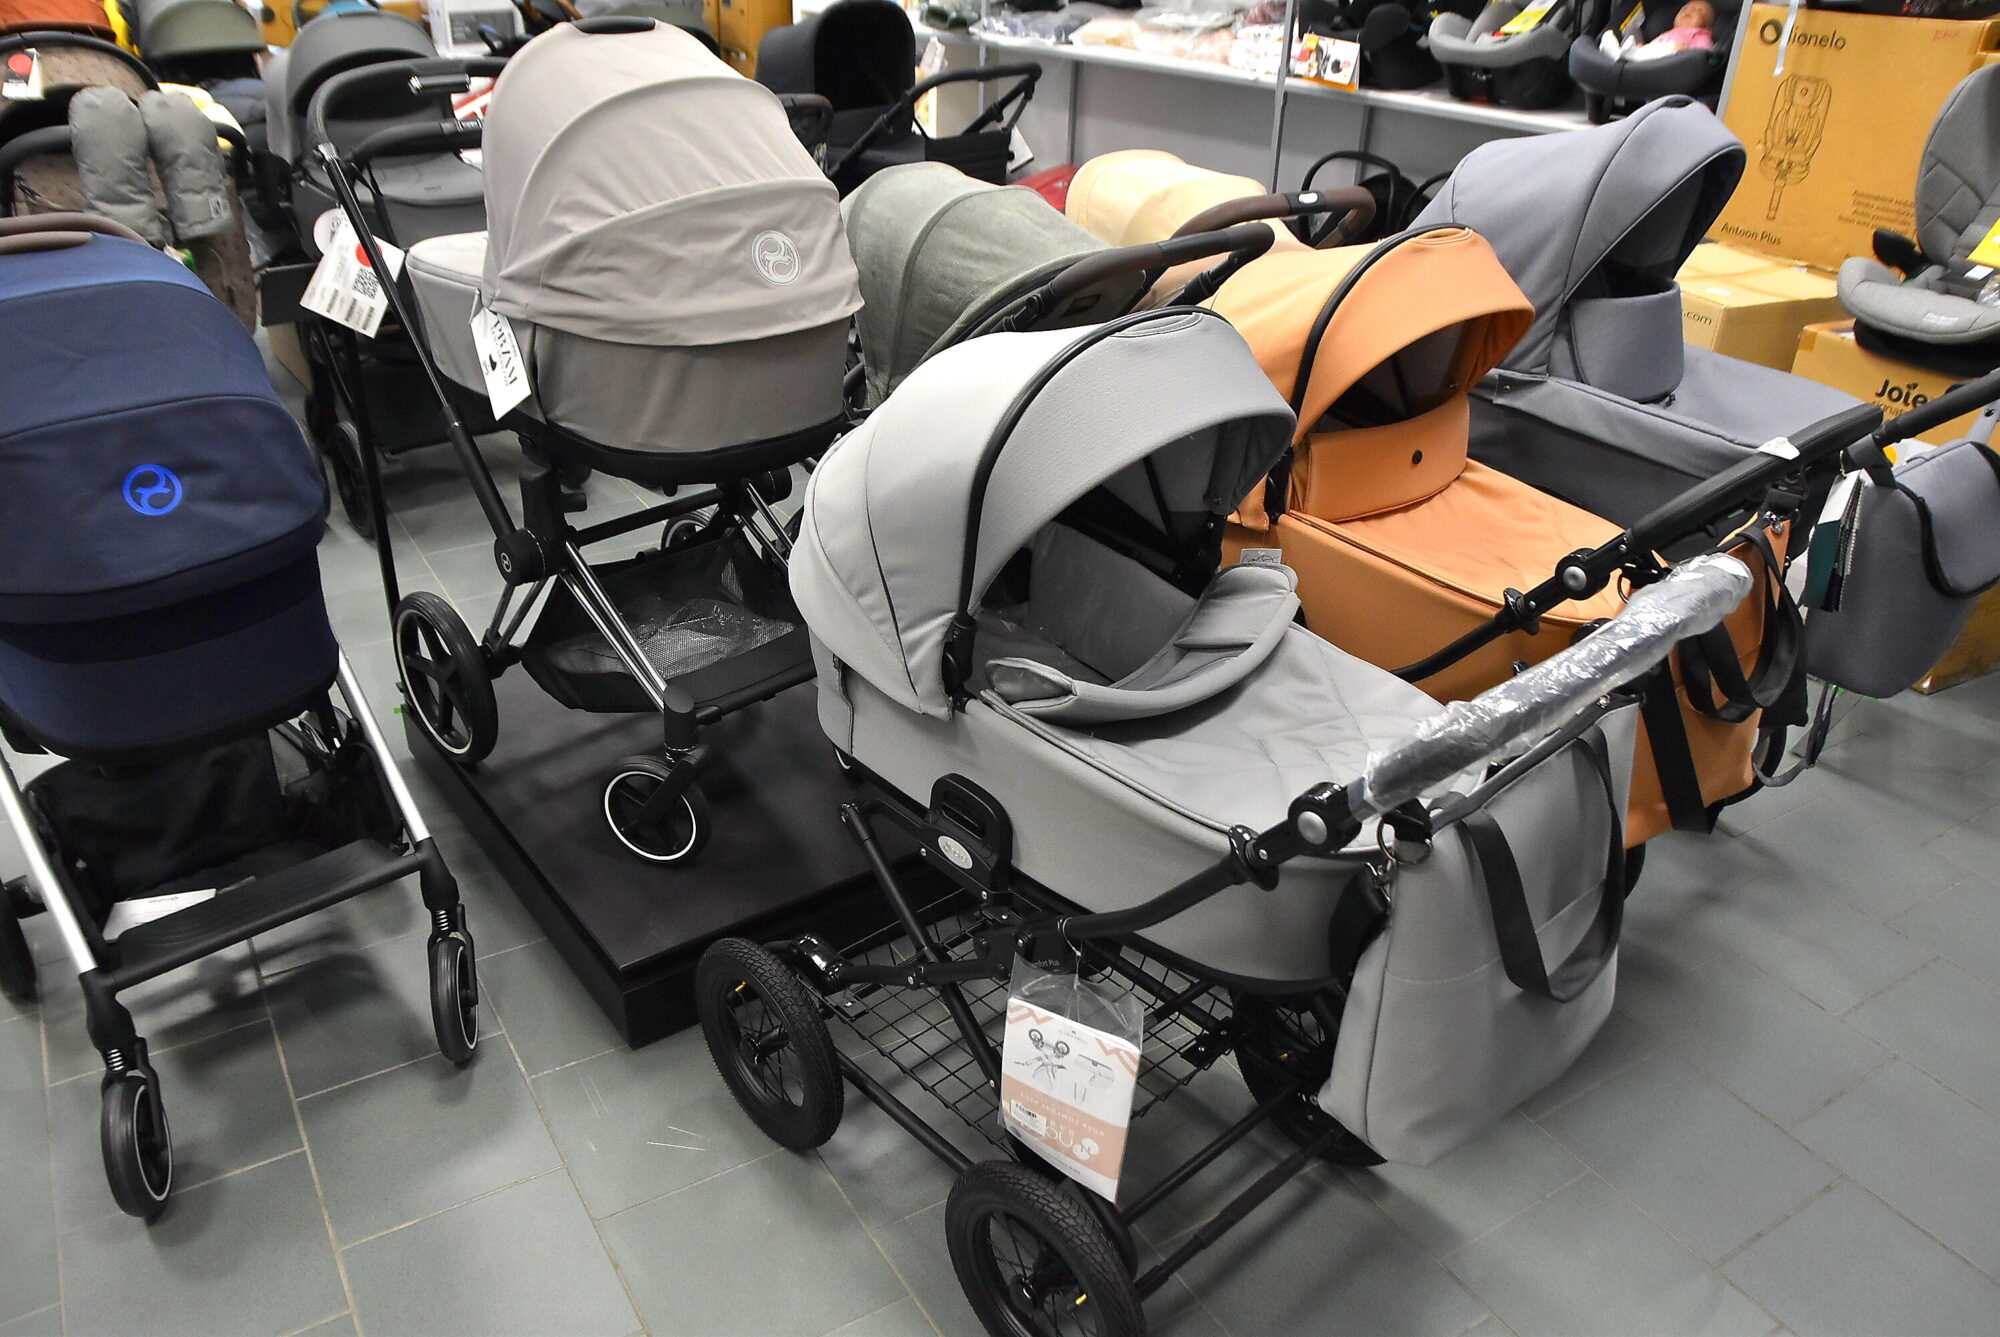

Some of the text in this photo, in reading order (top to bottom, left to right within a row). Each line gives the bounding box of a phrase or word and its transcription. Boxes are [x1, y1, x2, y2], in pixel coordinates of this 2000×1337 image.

[1787, 25, 1846, 50] lionelo
[1721, 222, 1782, 246] Antoon Plus
[1875, 379, 1928, 409] Joie
